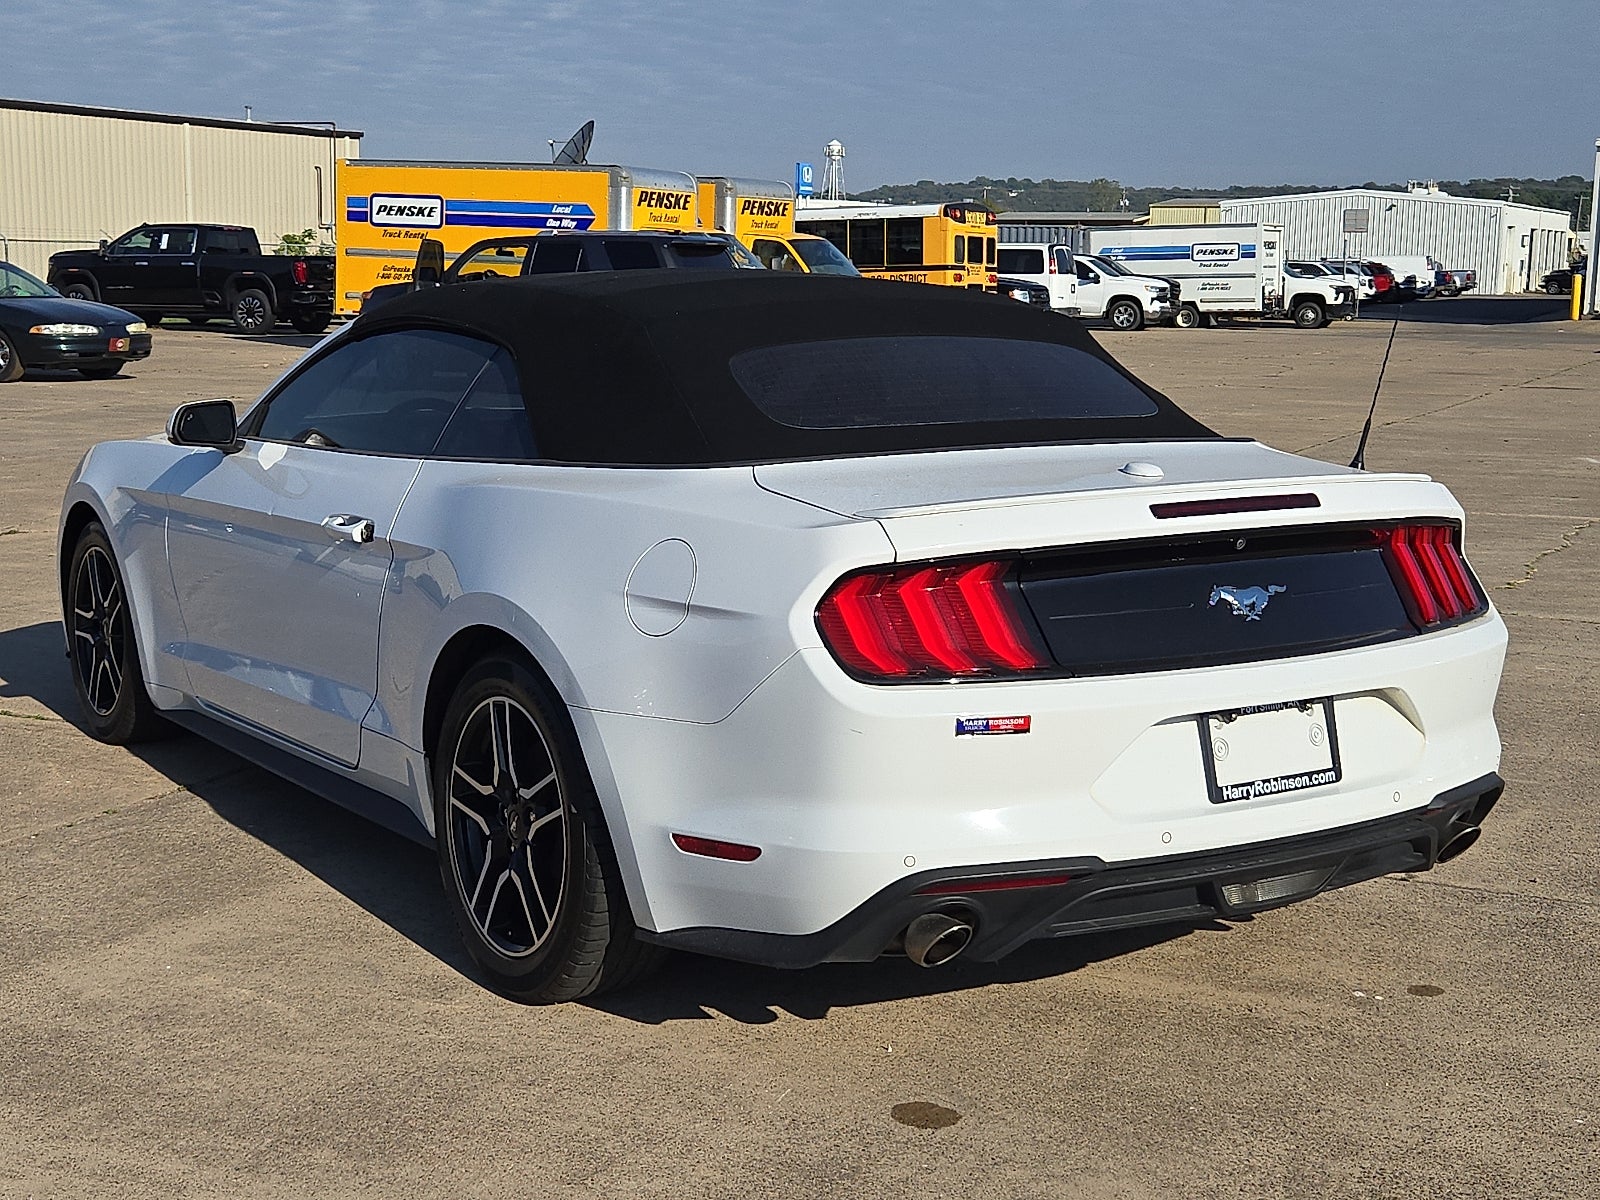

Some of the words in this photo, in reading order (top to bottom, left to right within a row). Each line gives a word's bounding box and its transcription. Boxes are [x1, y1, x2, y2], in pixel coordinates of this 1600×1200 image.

[637, 190, 691, 211] PENSKE
[376, 204, 438, 217] PENSKE
[551, 205, 573, 214] Local
[741, 200, 789, 217] PENSKE
[546, 219, 560, 228] One
[561, 219, 577, 229] Way
[382, 229, 402, 239] Truck
[403, 230, 428, 239] Rental
[1196, 248, 1236, 256] PENSKE
[889, 273, 928, 283] DISTRICT
[1222, 770, 1336, 800] HarryRobinson.com
